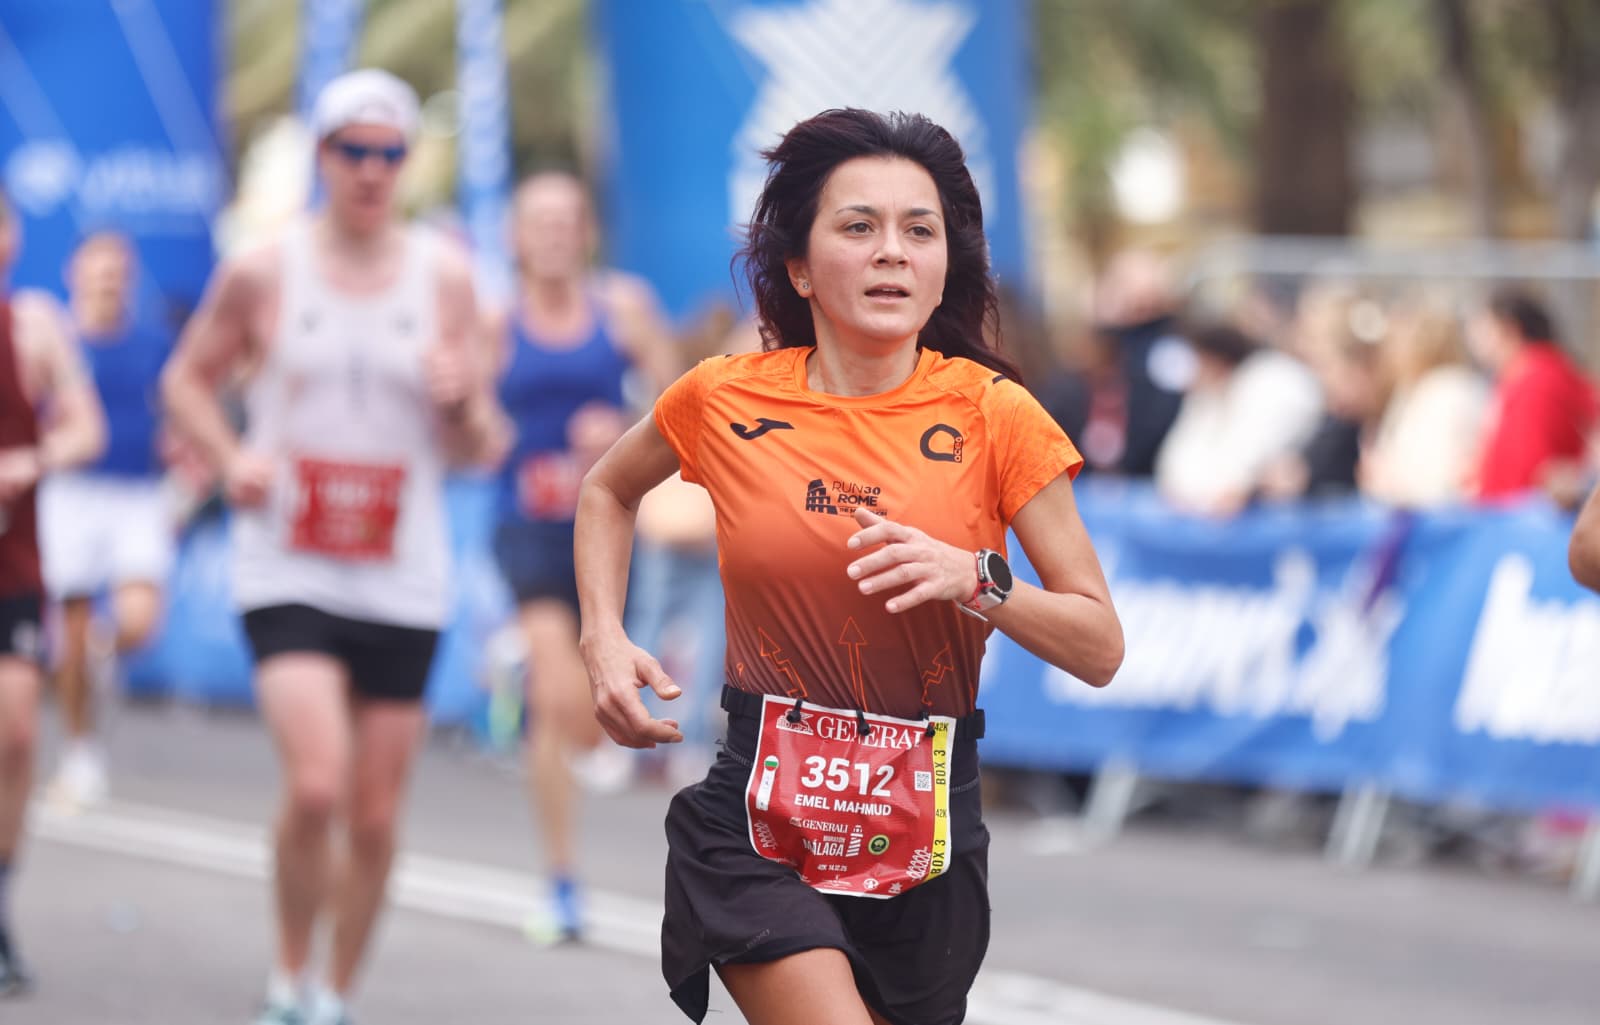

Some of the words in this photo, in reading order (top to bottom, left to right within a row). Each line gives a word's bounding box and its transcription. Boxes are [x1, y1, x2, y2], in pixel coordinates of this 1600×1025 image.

[838, 494, 878, 506] ROME
[801, 755, 895, 797] 3512
[935, 762, 946, 785] BOX
[794, 794, 830, 810] EMEL
[834, 799, 892, 816] MAHMUD
[936, 808, 947, 817] 42K
[802, 819, 848, 833] GENERALI
[930, 852, 944, 874] BOX
